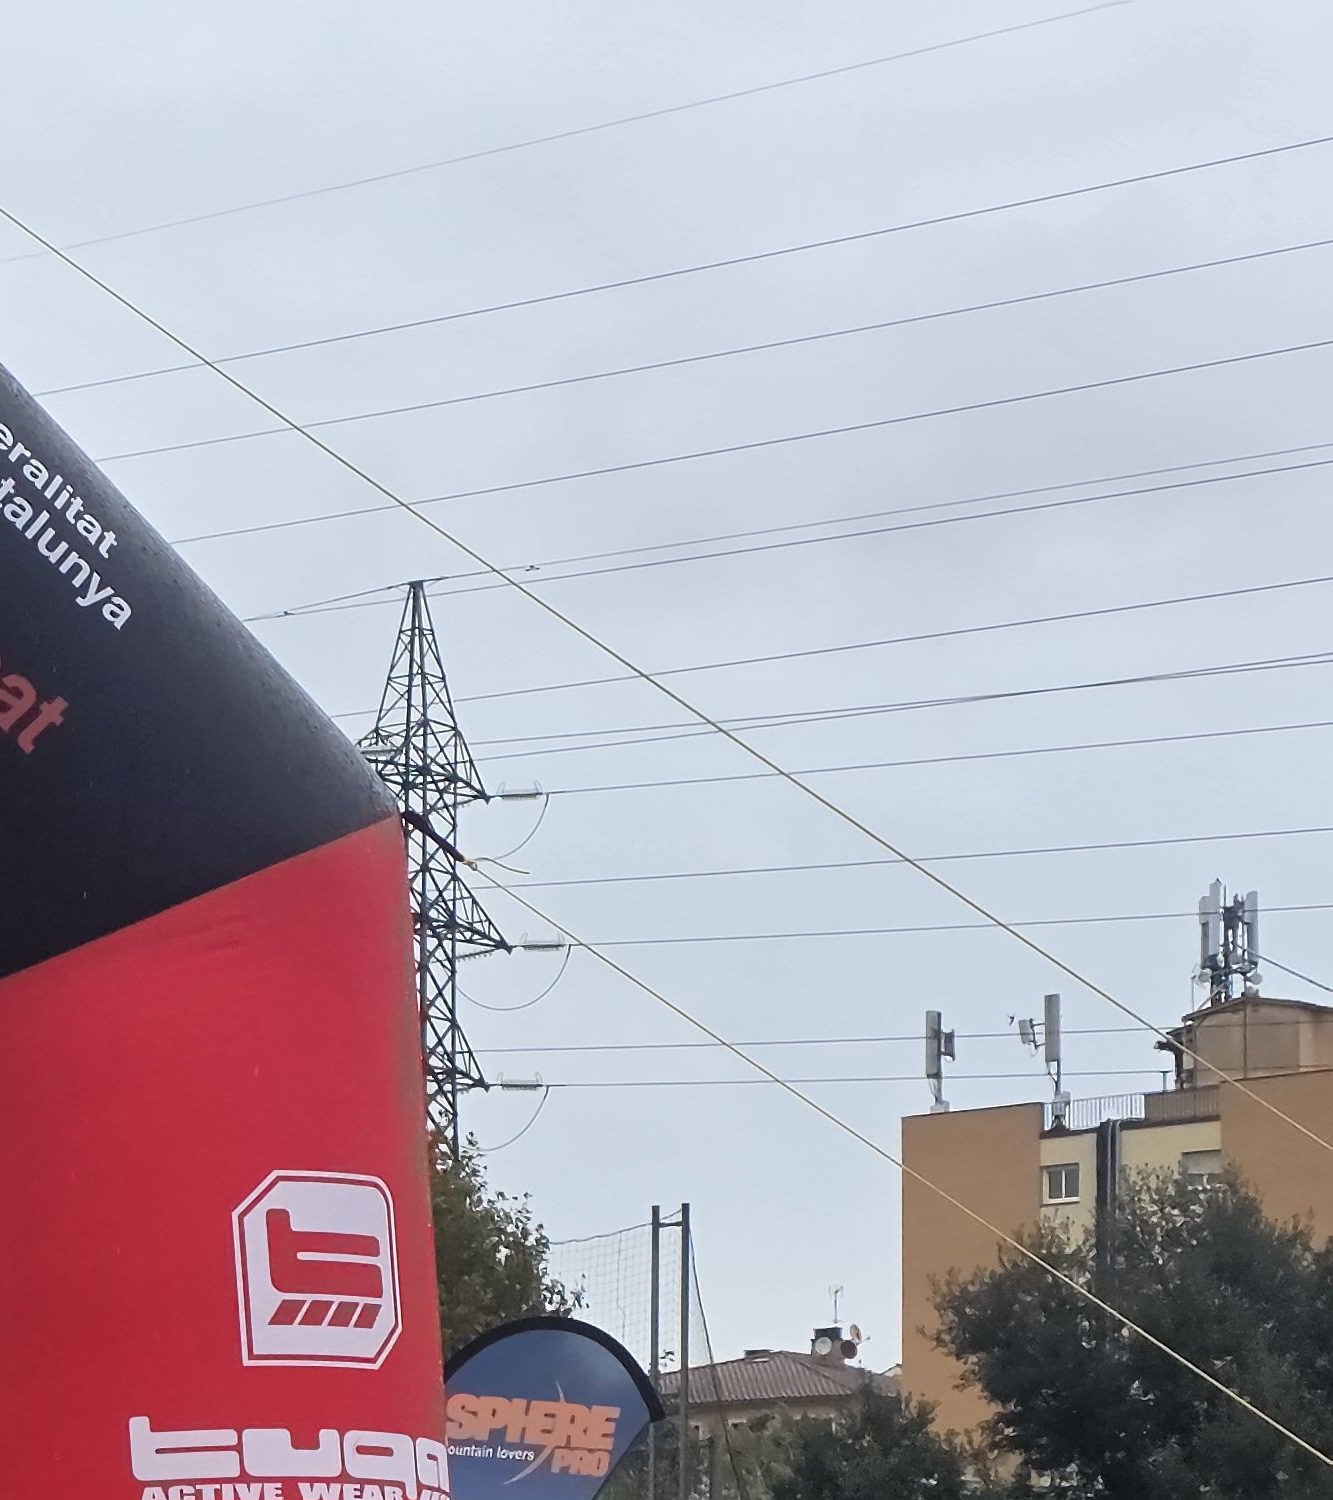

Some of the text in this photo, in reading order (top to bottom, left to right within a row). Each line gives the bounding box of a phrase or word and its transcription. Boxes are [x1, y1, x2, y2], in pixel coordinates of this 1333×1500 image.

[445, 1393, 622, 1450] SPHERE
[446, 1443, 535, 1461] ountain lovers
[551, 1448, 611, 1477] PRO
